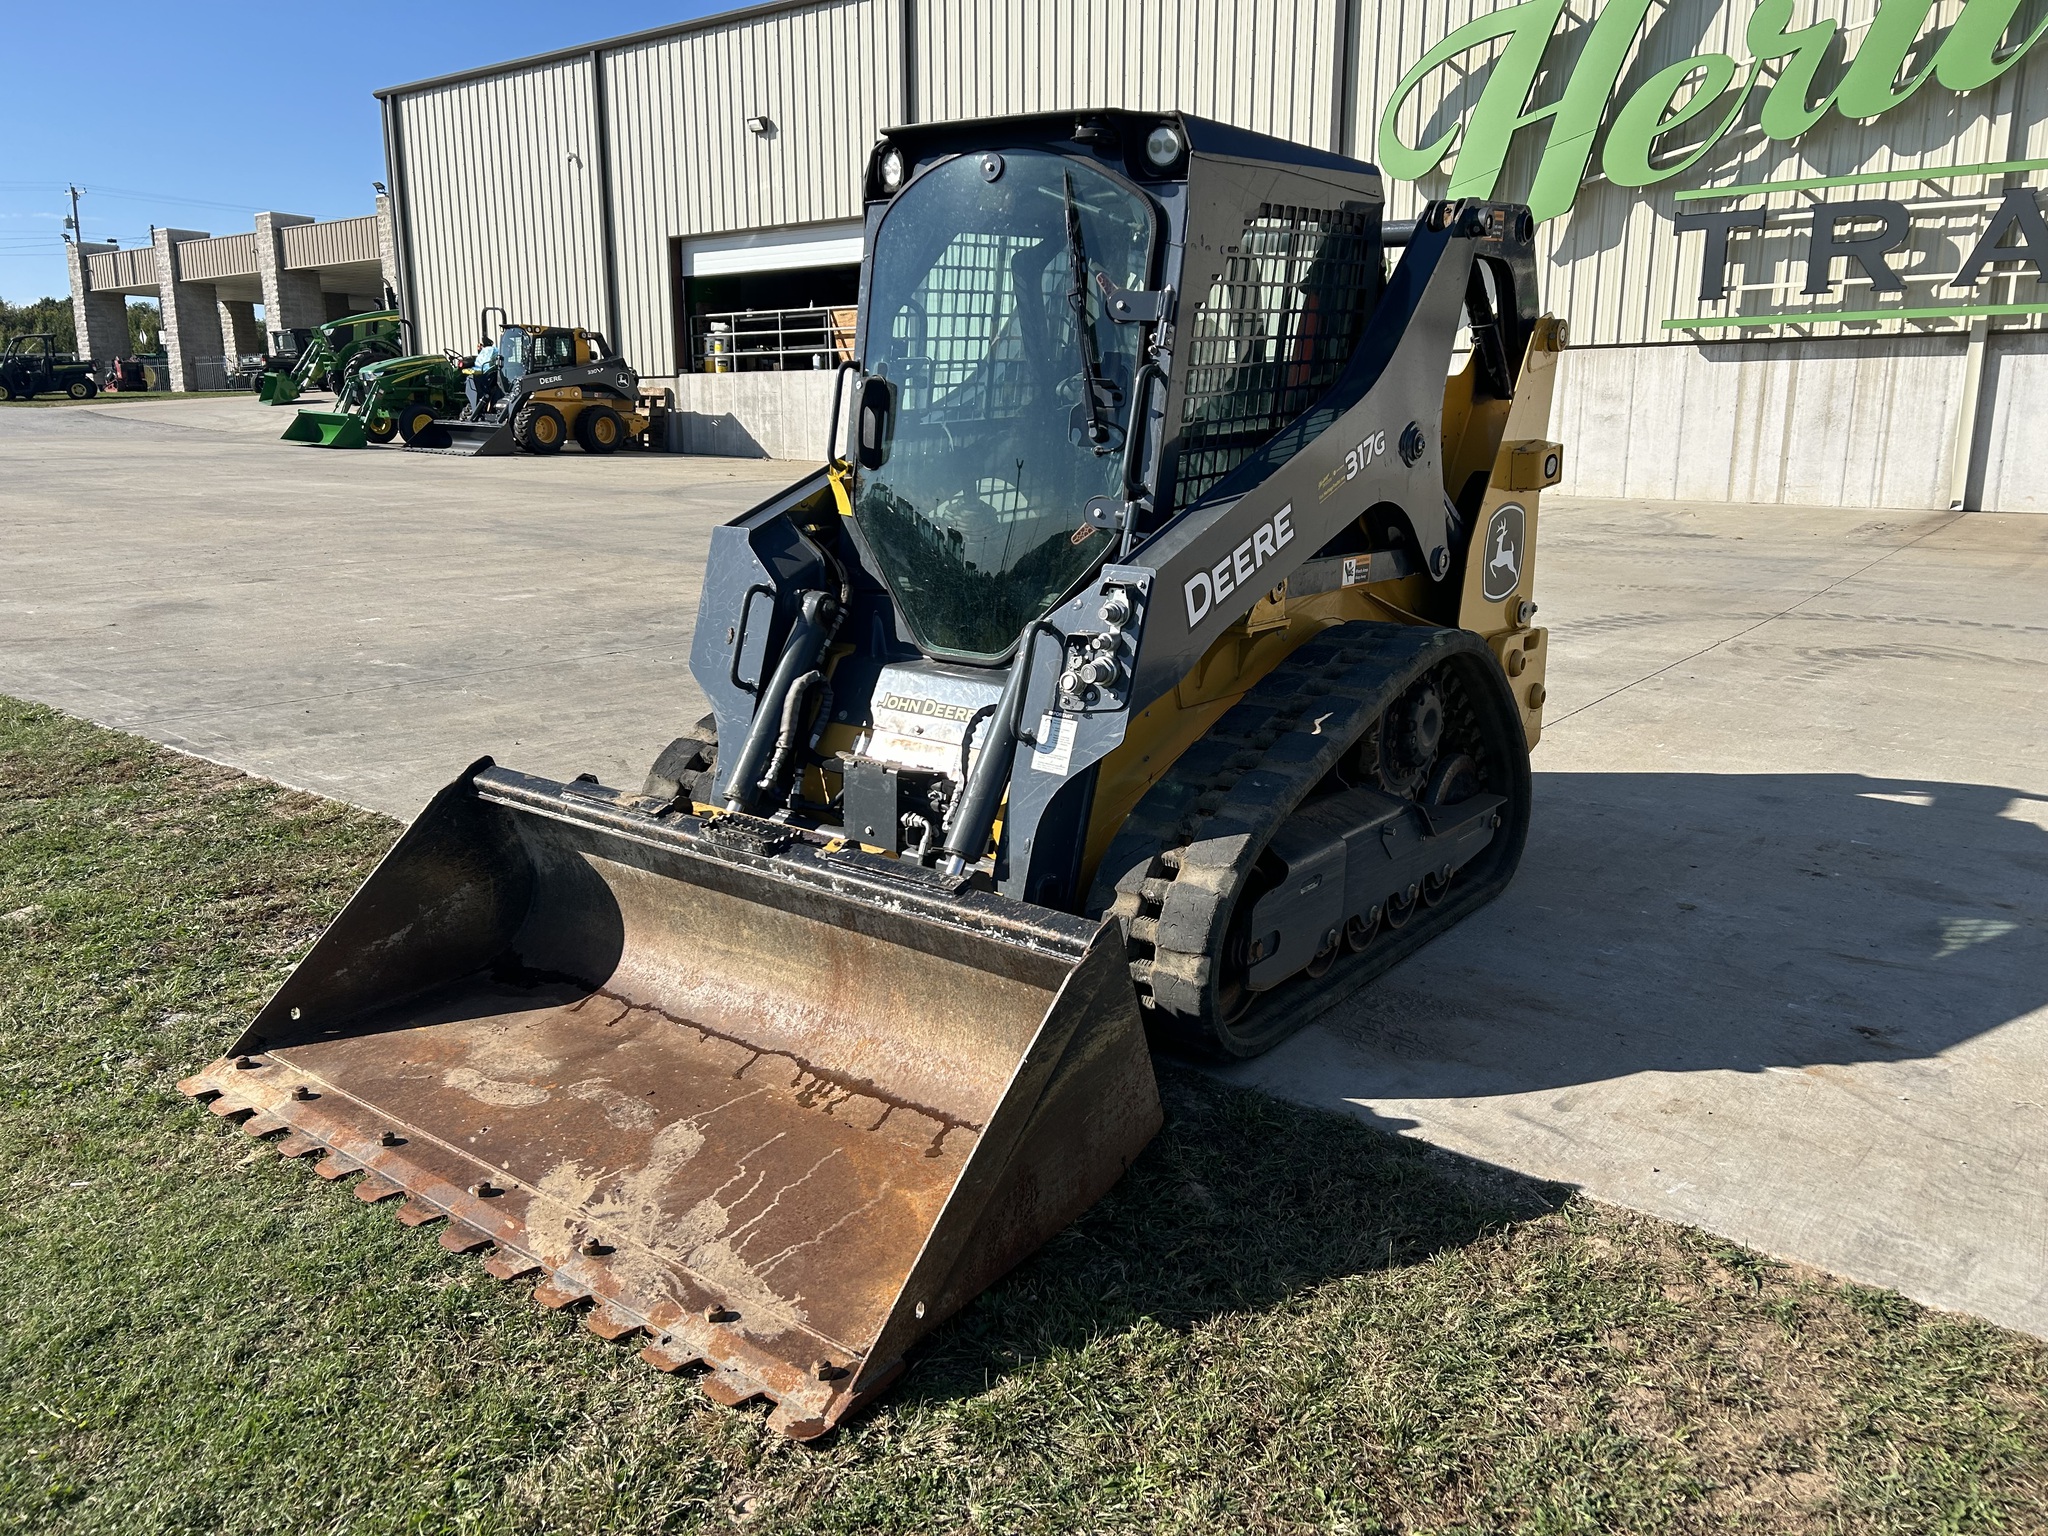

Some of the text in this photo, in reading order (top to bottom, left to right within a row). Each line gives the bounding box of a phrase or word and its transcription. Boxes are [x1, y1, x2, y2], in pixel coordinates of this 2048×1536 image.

[1674, 187, 2048, 301] TRA
[539, 375, 563, 385] DEERE
[1344, 429, 1386, 481] 317G
[1184, 503, 1295, 628] DEERE
[877, 692, 921, 714] JOHN
